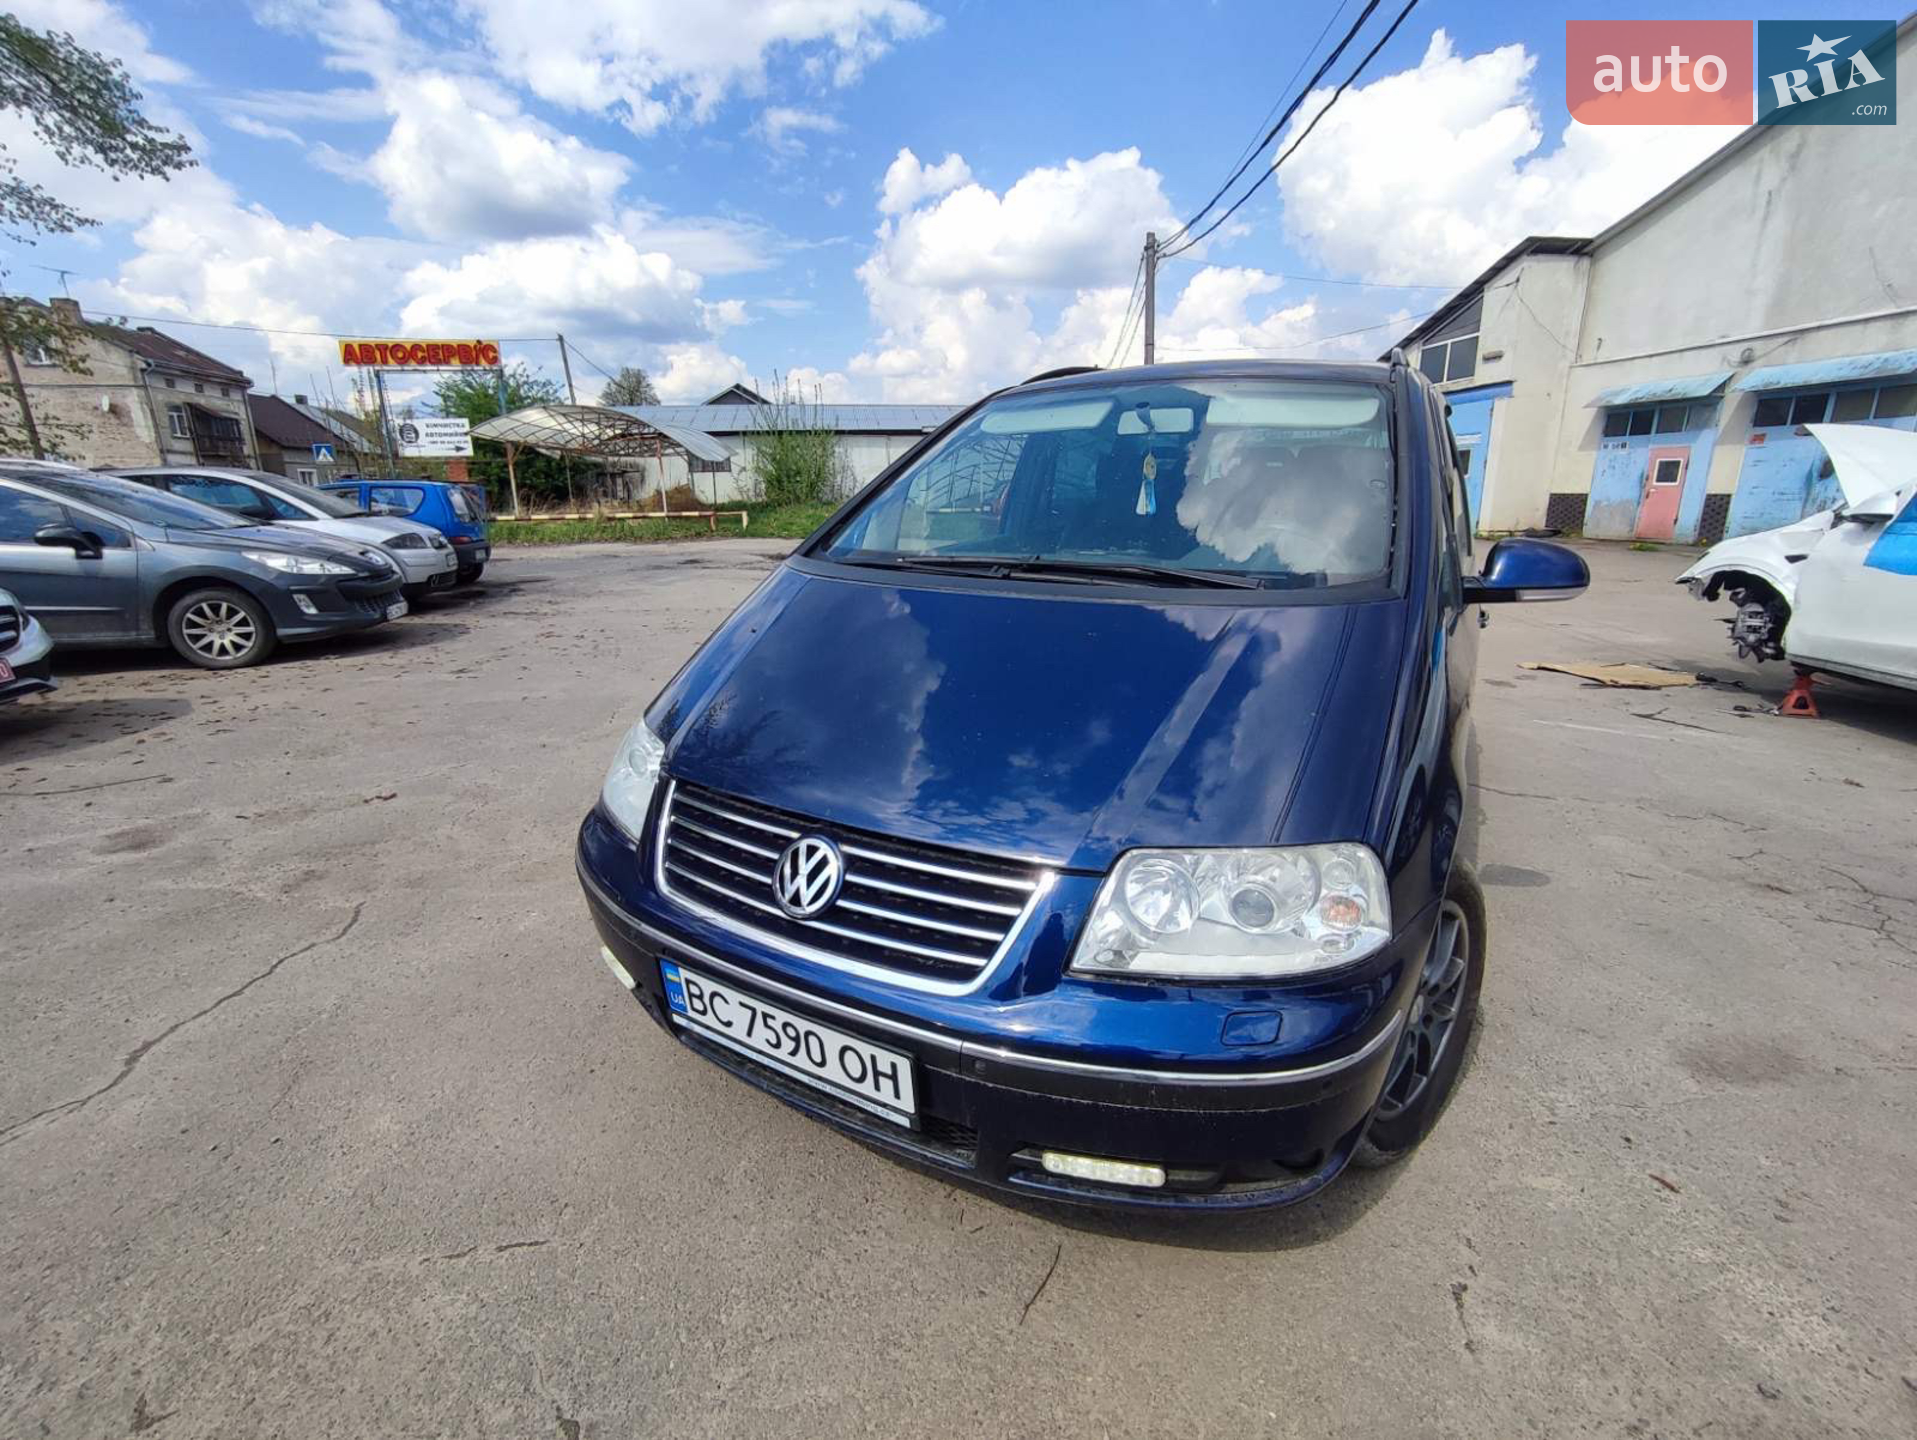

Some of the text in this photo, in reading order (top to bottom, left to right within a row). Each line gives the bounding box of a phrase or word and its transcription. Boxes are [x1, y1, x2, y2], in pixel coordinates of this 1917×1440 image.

[343, 340, 499, 365] АВТОСЕРВІС
[671, 991, 685, 1006] UA
[685, 977, 734, 1029] BC
[739, 1001, 828, 1069] 7590
[838, 1044, 902, 1100] OH
